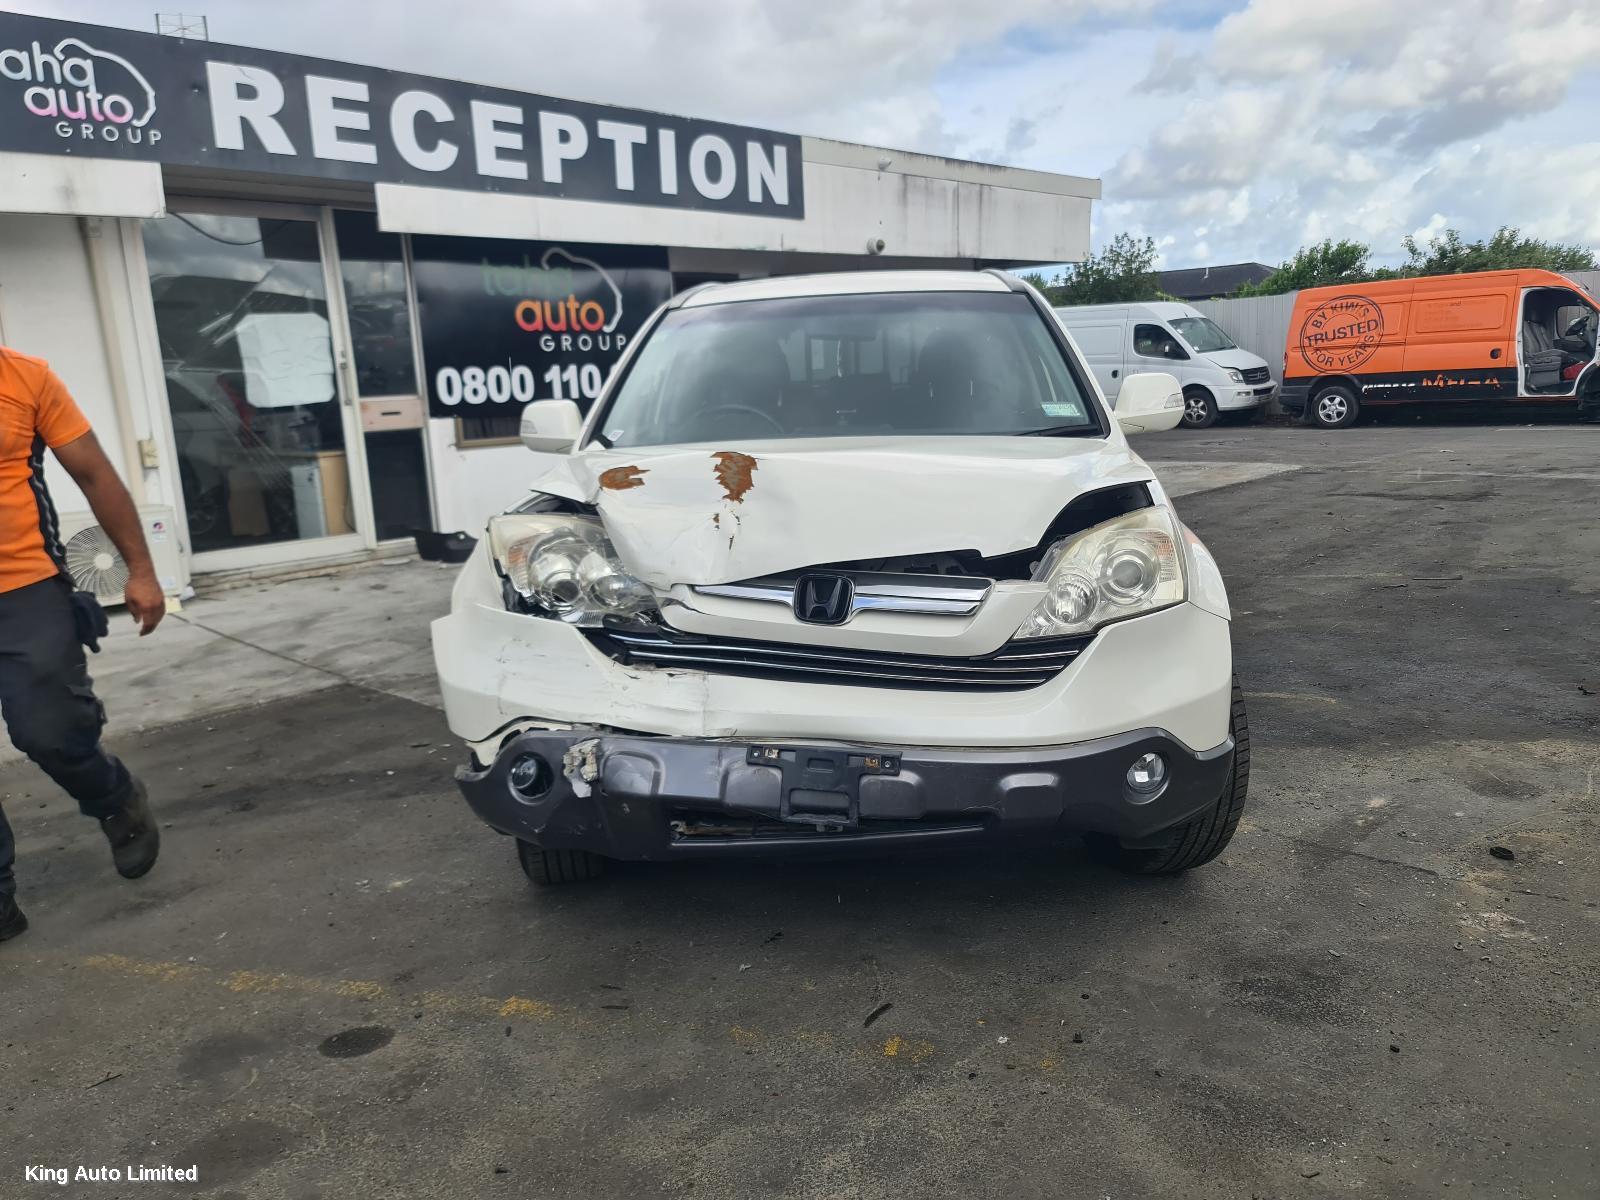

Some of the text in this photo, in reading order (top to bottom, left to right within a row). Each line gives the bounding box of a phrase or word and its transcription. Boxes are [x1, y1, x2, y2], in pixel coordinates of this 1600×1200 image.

[24, 87, 134, 124] auto
[56, 122, 162, 145] GROUP
[205, 61, 789, 206] RECEPTION
[515, 293, 605, 331] auto
[1312, 312, 1327, 328] BY
[540, 335, 627, 351] GROUP
[1305, 319, 1379, 347] TRUSTED
[1311, 335, 1375, 367] FOR YEARS
[436, 363, 602, 405] 0800 110
